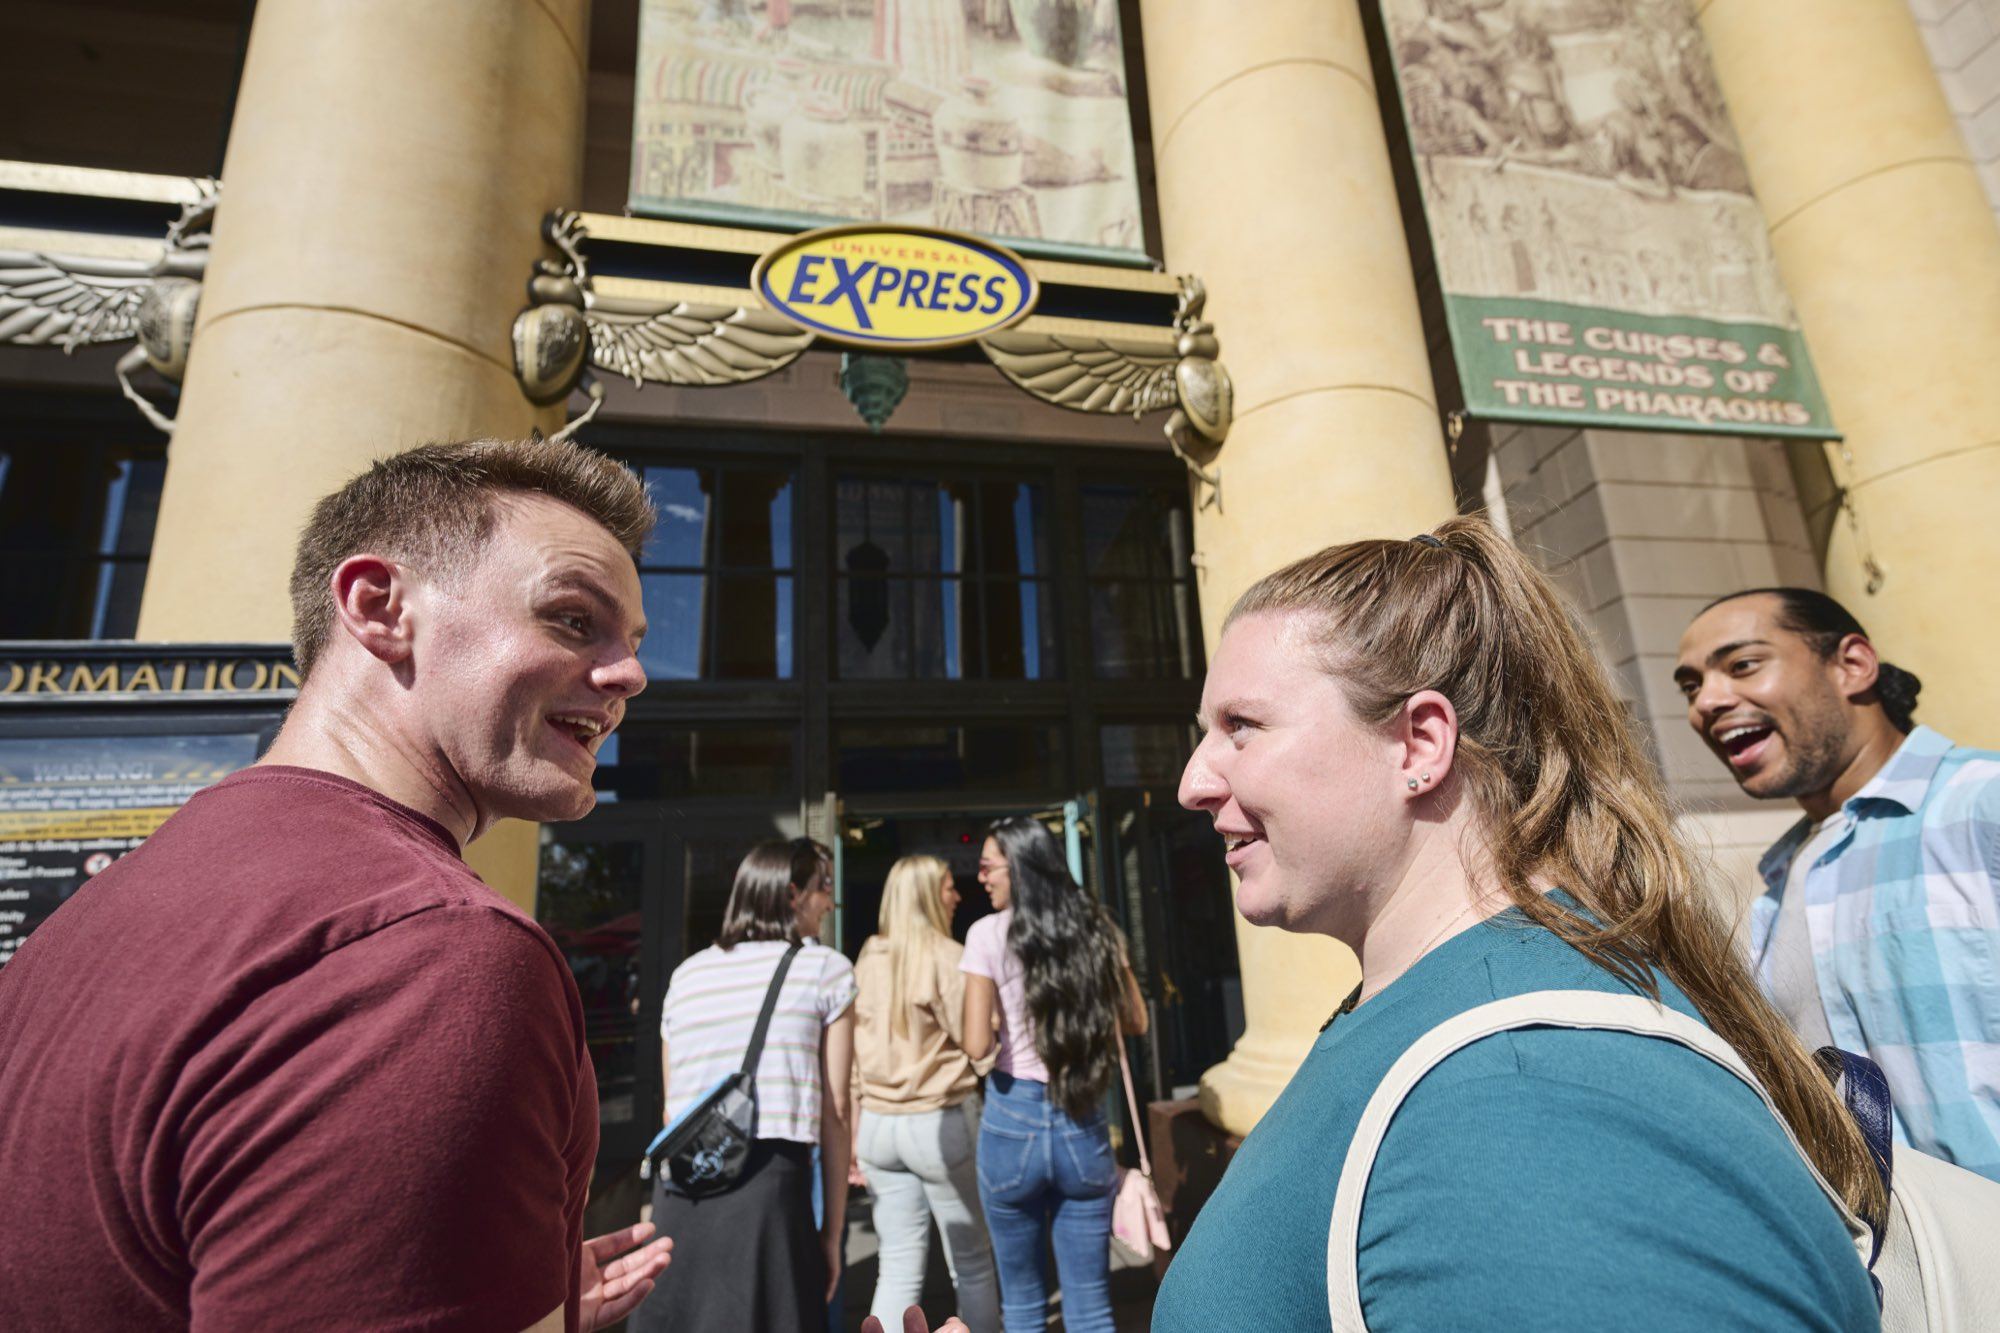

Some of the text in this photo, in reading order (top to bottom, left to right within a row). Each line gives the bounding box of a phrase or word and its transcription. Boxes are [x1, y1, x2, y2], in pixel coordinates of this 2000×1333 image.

[831, 240, 974, 265] UNIVERSAL
[787, 254, 1007, 330] EXPRESS
[1482, 316, 1792, 369] THE CURSES &
[1514, 348, 1778, 394] LEGENDS OF
[1494, 379, 1812, 426] THE PHARAOHS
